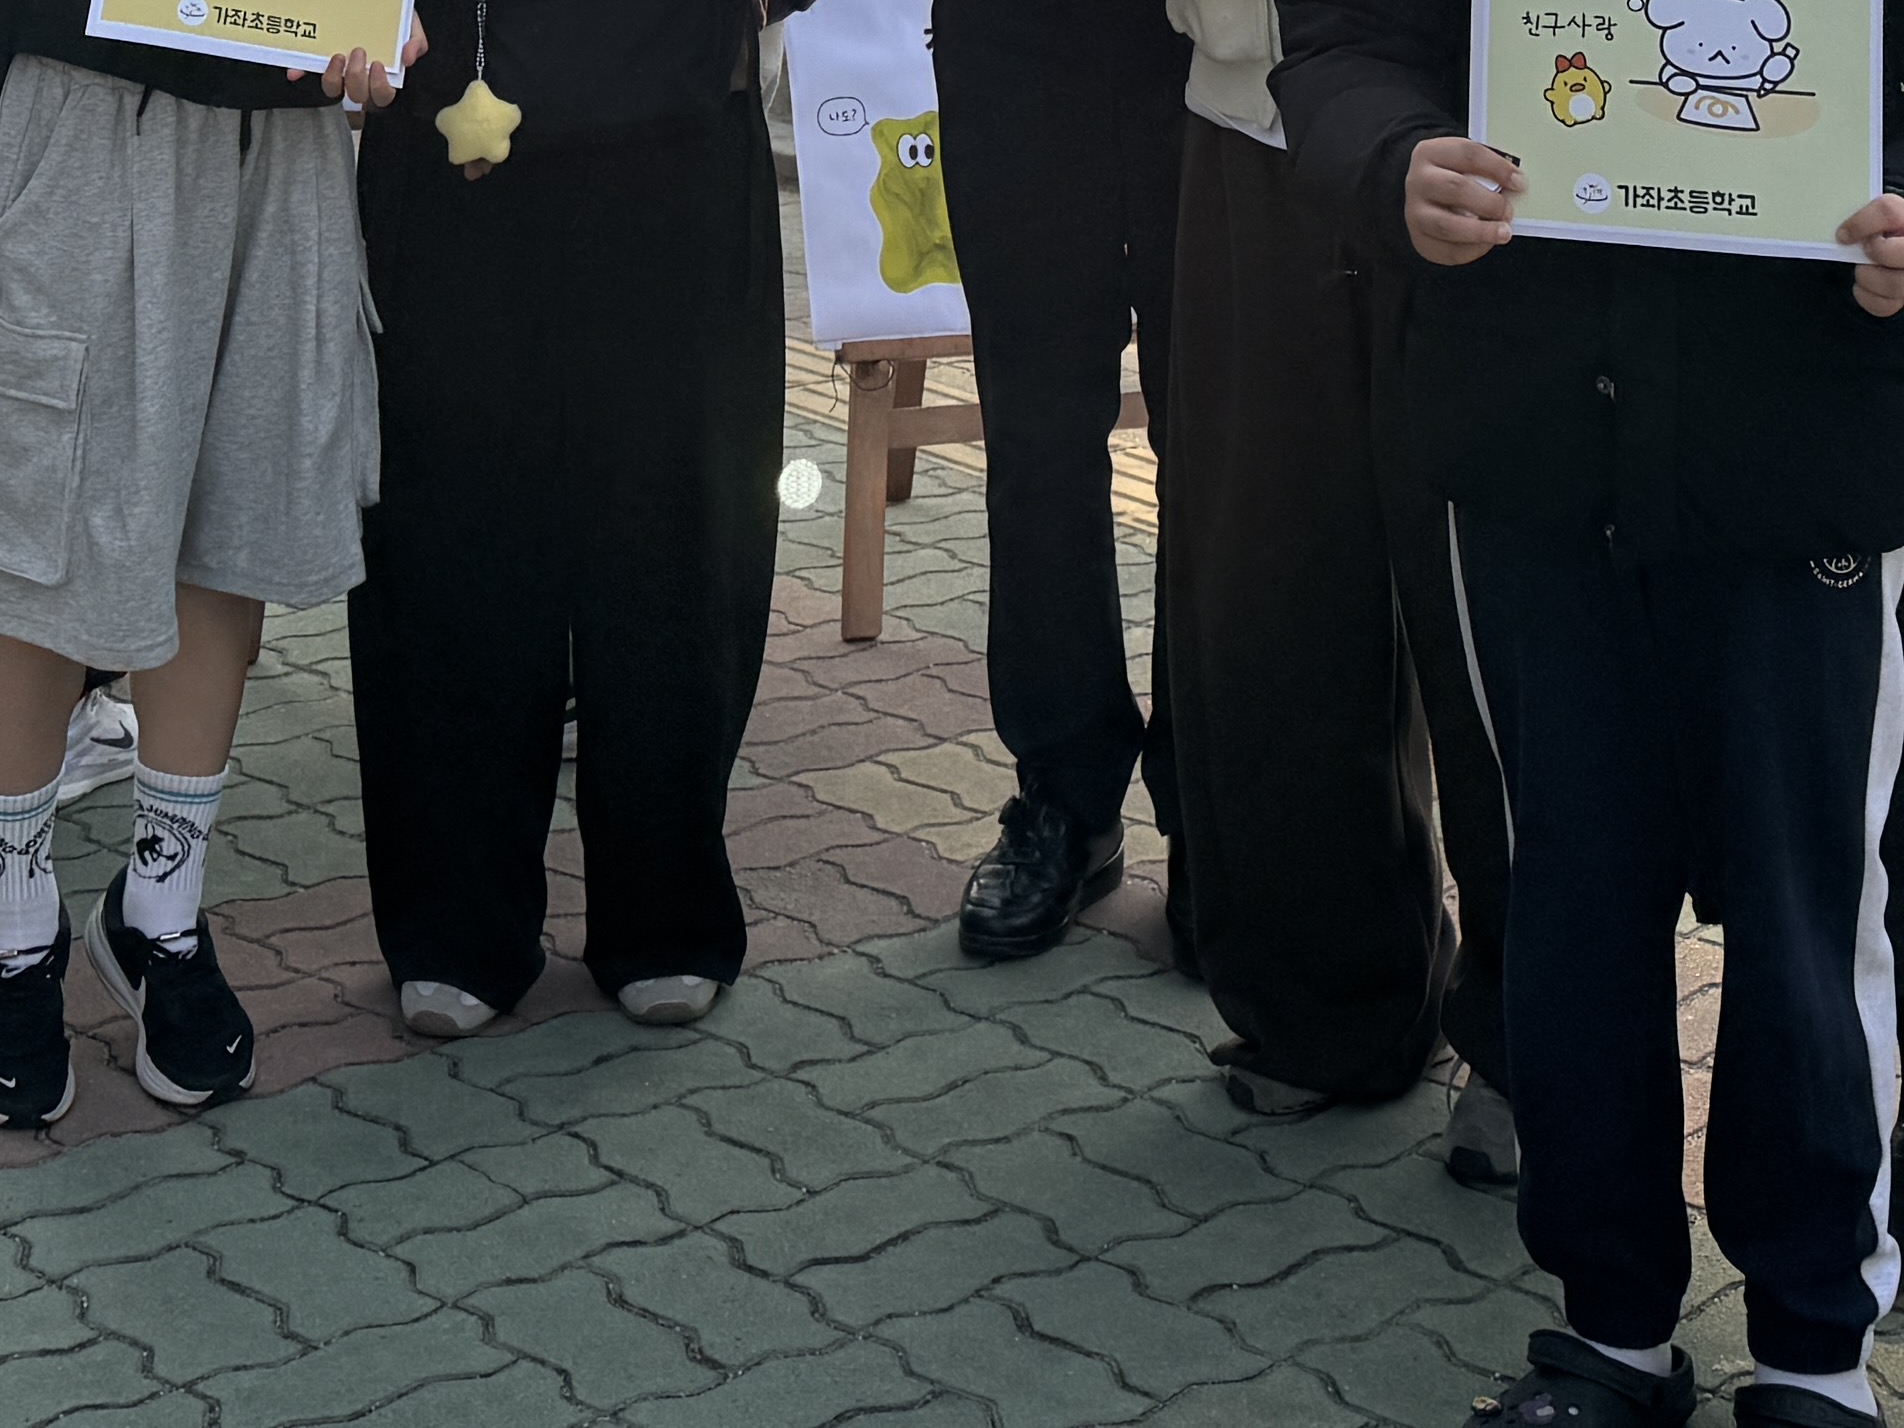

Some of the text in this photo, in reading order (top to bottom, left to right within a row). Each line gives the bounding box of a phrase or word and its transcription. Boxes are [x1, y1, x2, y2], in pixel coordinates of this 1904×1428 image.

[212, 5, 317, 39] 가좌초등학교
[1522, 11, 1618, 41] 친구사랑
[829, 108, 857, 122] 나도?
[1616, 184, 1758, 216] 가좌초등학교
